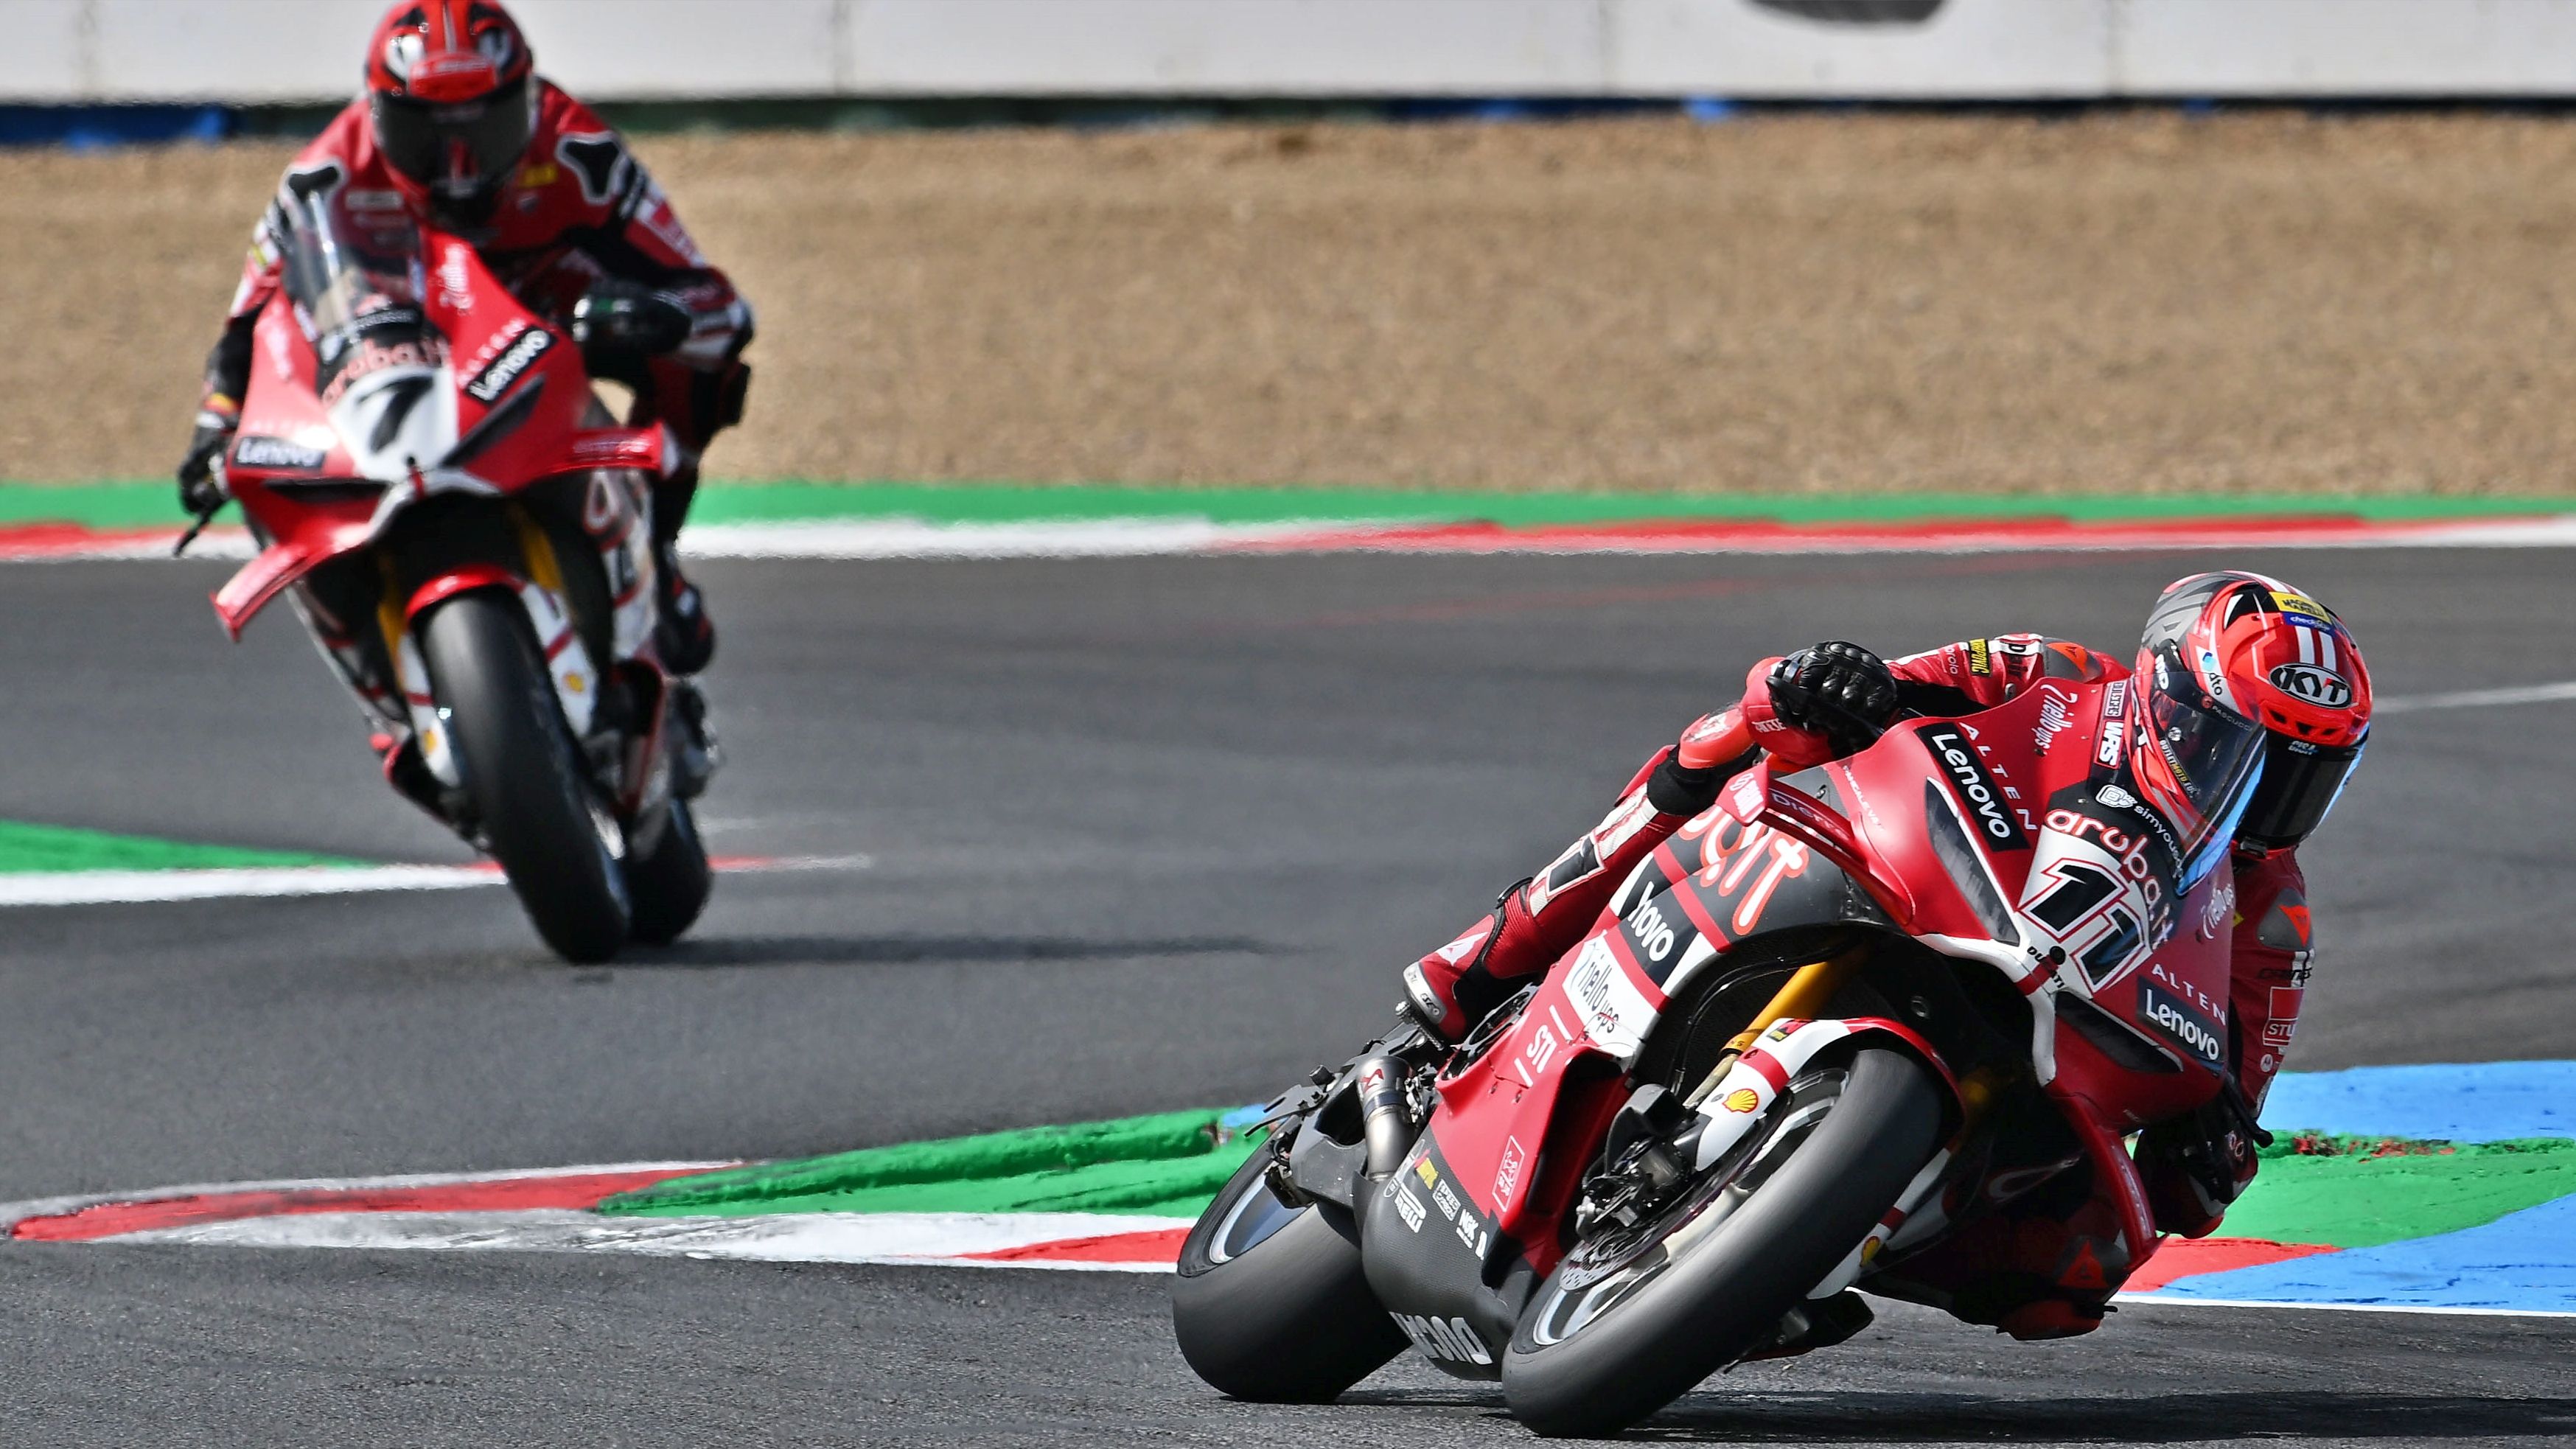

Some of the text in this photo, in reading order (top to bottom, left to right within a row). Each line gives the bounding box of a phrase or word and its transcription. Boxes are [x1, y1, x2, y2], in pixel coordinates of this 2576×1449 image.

[470, 329, 551, 401] Lenovo
[236, 436, 326, 467] Lenovo
[355, 375, 435, 456] 7
[2269, 667, 2349, 703] KYT
[2031, 694, 2075, 750] riello ups
[2098, 721, 2125, 767] WRS
[1932, 733, 2011, 839] Lenovo
[1958, 722, 2039, 831] ALTEN
[2018, 858, 2154, 992] 11
[2145, 988, 2220, 1060] Lenovo
[2152, 963, 2227, 1026] ALTEN
